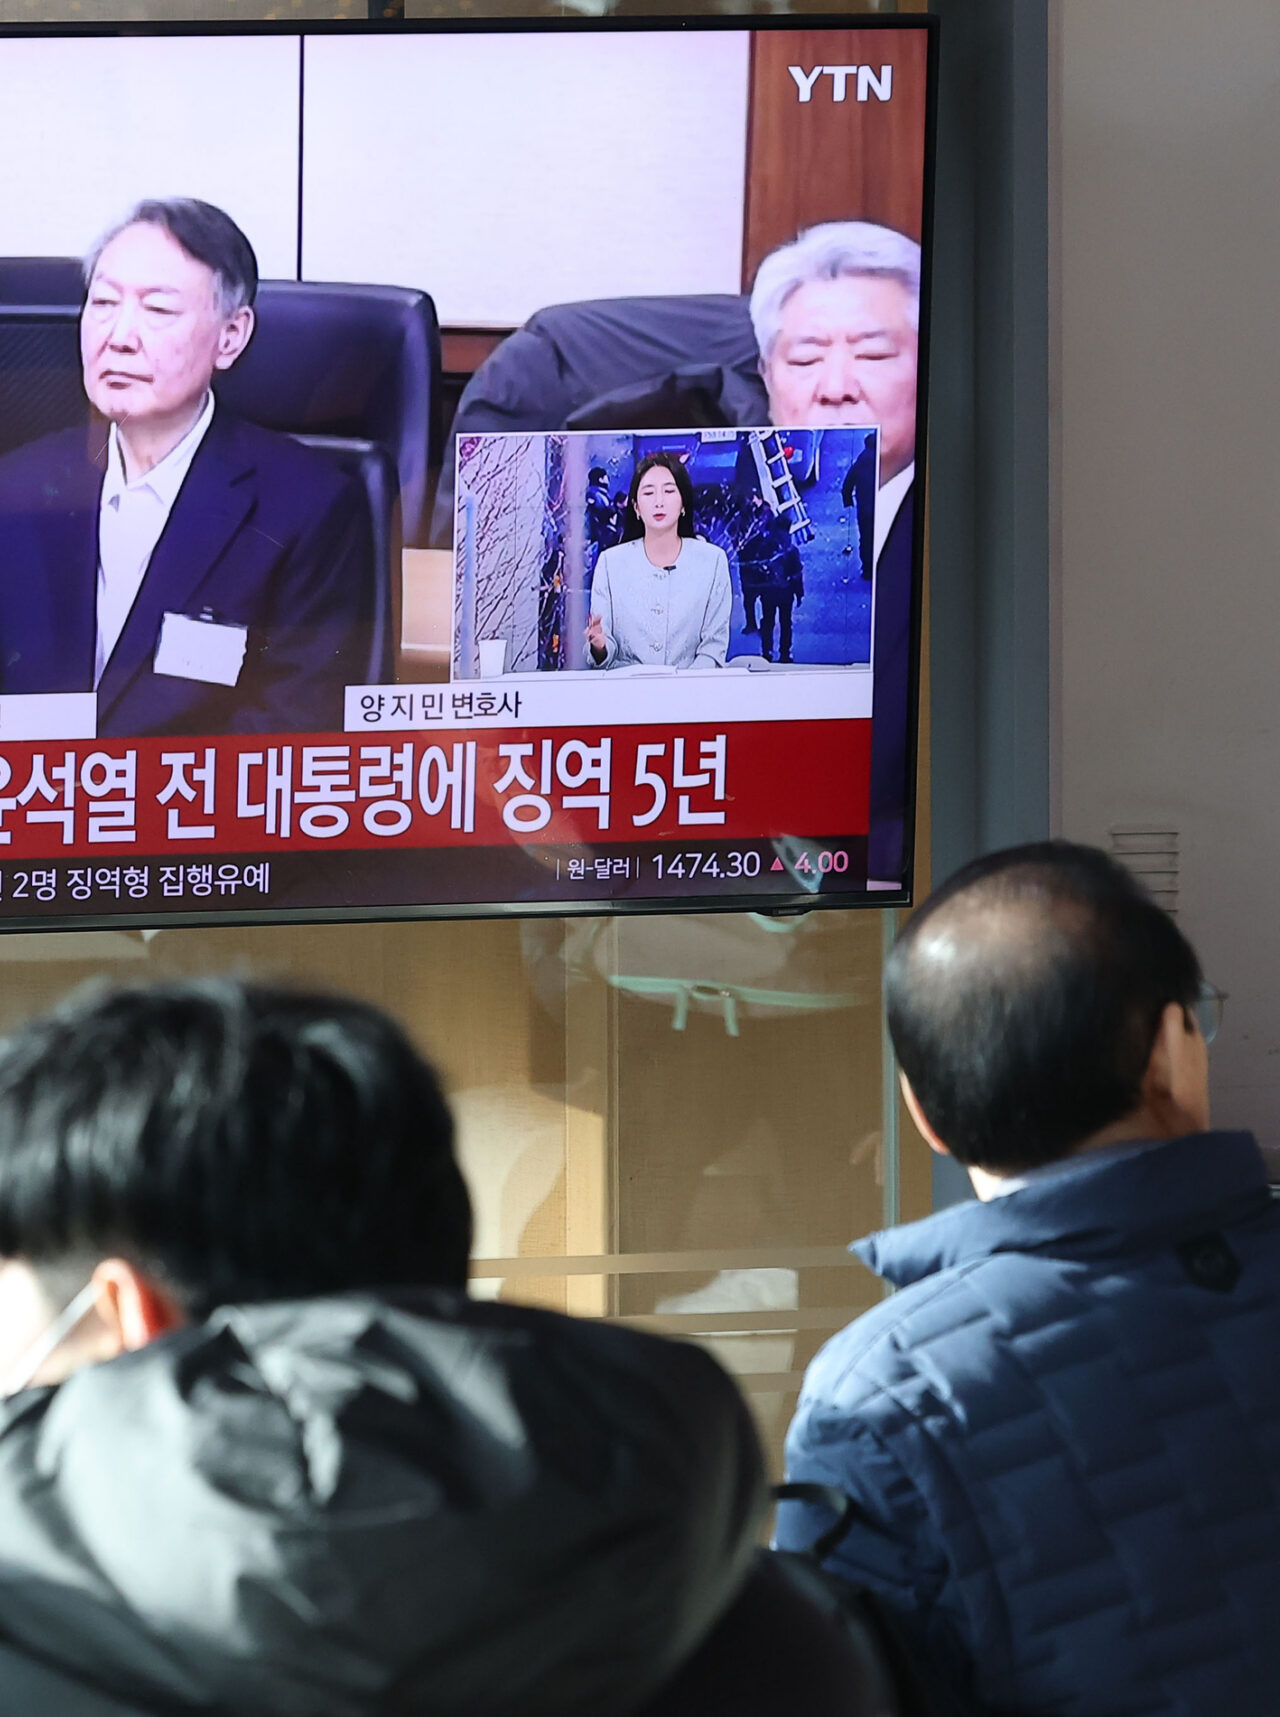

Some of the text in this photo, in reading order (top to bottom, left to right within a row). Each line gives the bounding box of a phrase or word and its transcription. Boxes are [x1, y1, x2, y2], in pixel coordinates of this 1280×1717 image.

[787, 64, 894, 103] YTN
[451, 691, 522, 720] 변호사
[155, 747, 217, 840] 전
[235, 741, 478, 839] 대통령에
[493, 737, 613, 833] 징역
[630, 734, 727, 828] 5년
[12, 869, 58, 901] 2명
[65, 867, 150, 899] 징역형
[158, 862, 270, 898] 집행유예
[567, 850, 850, 880] 원-달러 1474.30 4.00
